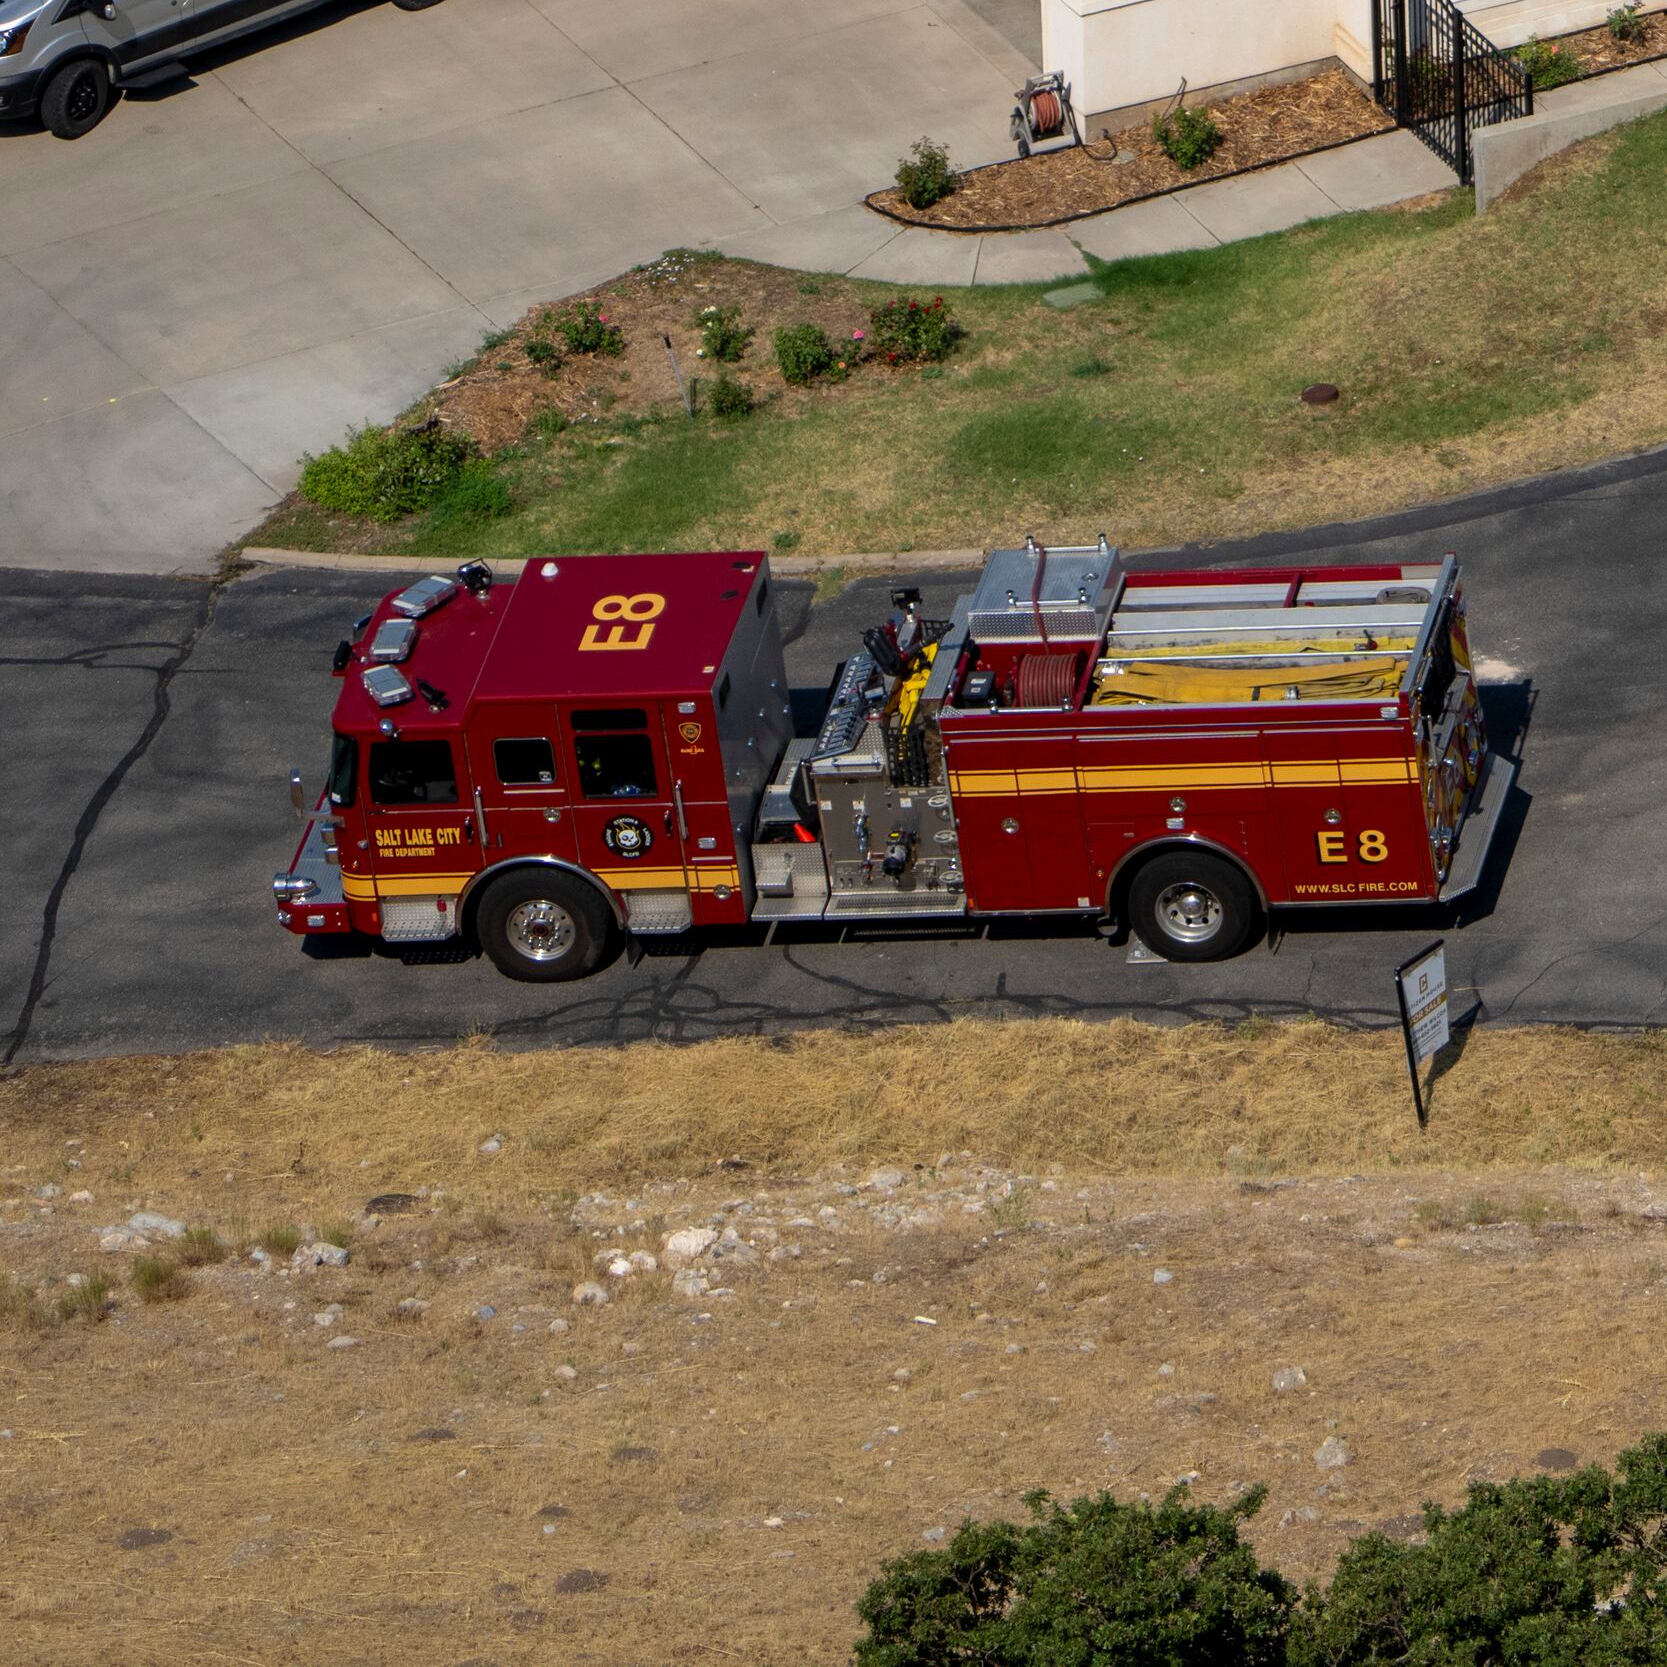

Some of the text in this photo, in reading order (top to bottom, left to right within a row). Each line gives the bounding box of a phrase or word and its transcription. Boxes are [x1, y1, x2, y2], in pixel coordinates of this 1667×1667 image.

[375, 827, 460, 847] SALT LAKE CITY
[379, 847, 436, 858] FIRE DEPARTMENT
